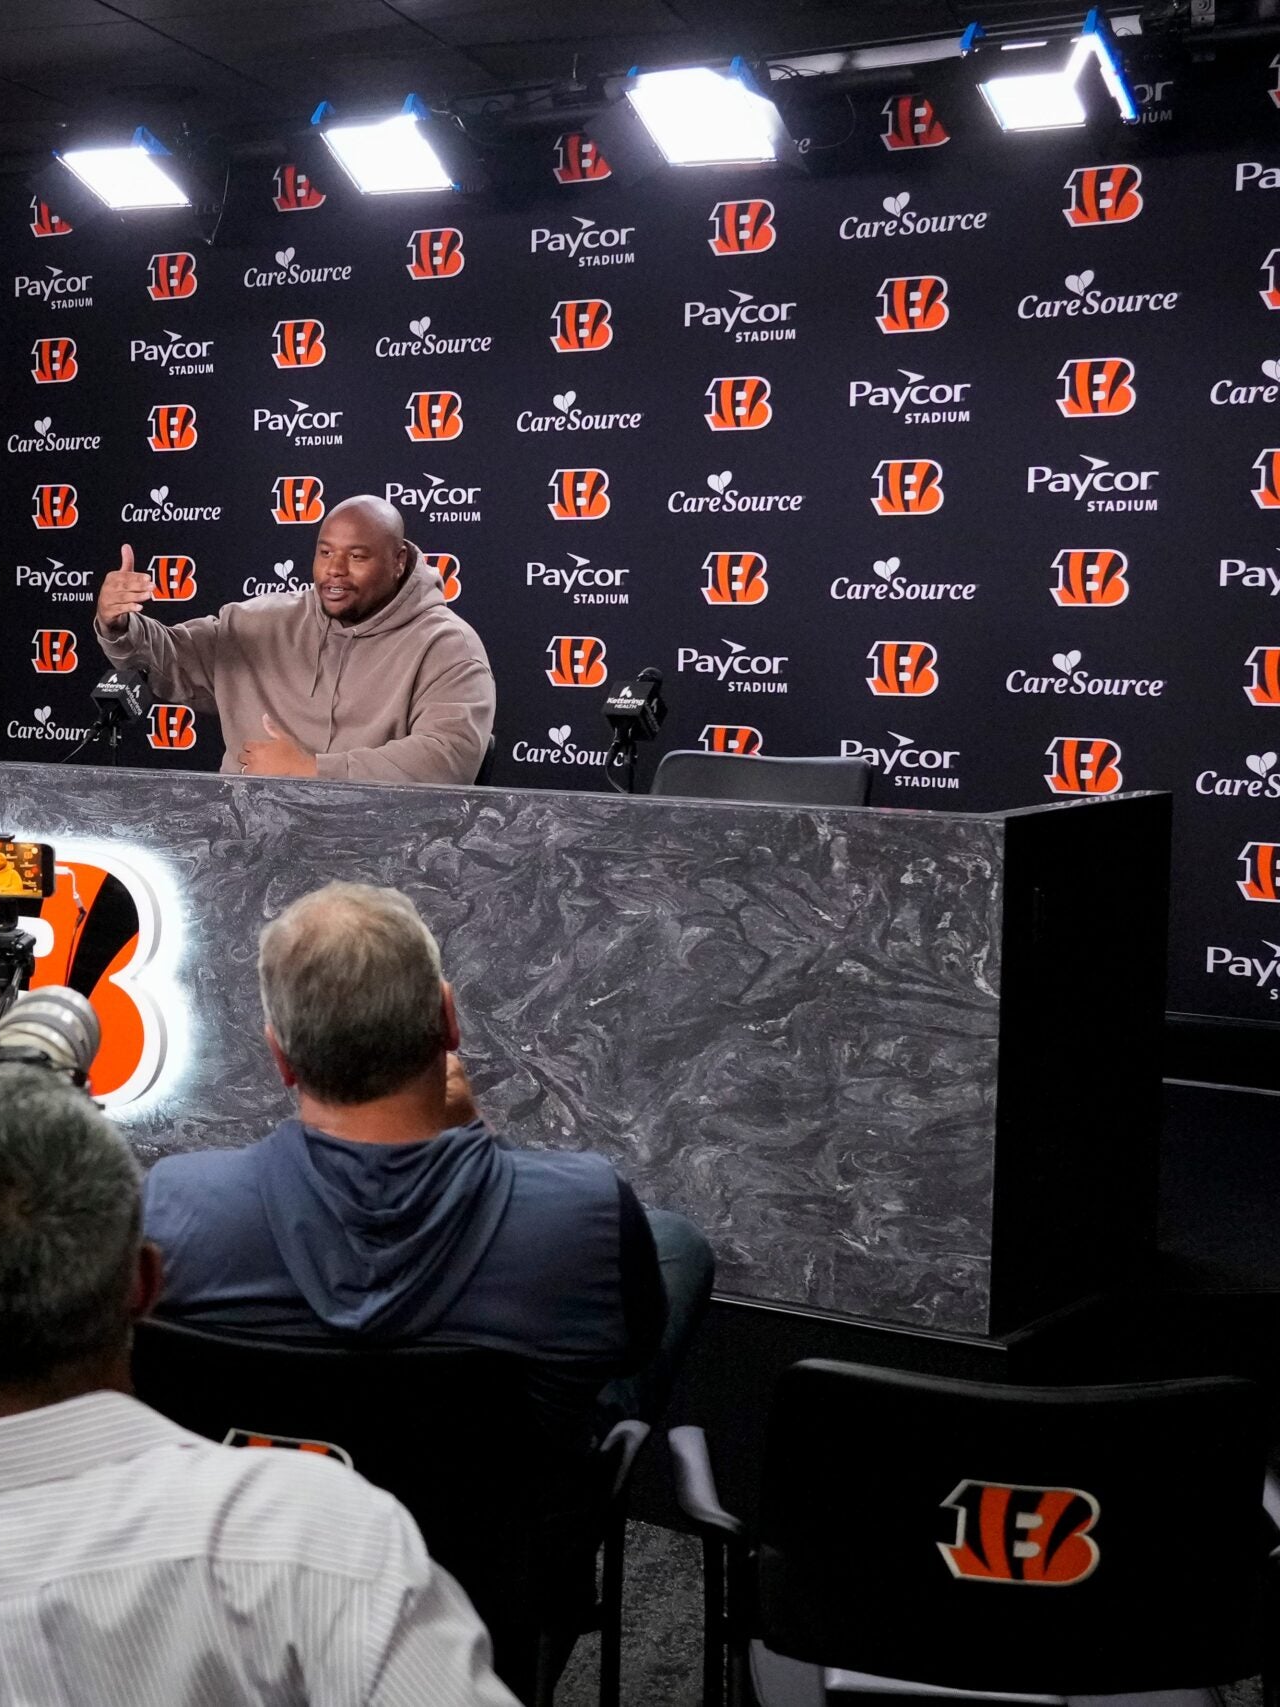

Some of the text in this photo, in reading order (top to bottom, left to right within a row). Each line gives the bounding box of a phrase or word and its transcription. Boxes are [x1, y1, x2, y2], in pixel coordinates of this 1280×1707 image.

[840, 212, 987, 239] CareSource
[532, 228, 635, 257] Paycor
[579, 253, 634, 267] STADIUM
[244, 264, 351, 287] CareSource
[16, 276, 92, 301] Paycor
[51, 298, 92, 309] STADIUM
[1018, 291, 1177, 319] CareSource
[685, 302, 796, 332] Paycor
[376, 334, 491, 357] CareSource
[736, 329, 795, 342] STADIUM
[131, 341, 213, 366] Paycor
[169, 364, 213, 375] STADIUM
[850, 382, 970, 413] Paycor
[255, 409, 343, 436] Paycor
[517, 409, 641, 432] CareSource
[905, 411, 969, 424] STADIUM
[8, 433, 100, 452] CareSource
[295, 435, 342, 446] STADIUM
[1028, 467, 1159, 500] Paycor
[386, 483, 481, 512] Paycor
[668, 490, 802, 512] CareSource
[1088, 500, 1157, 511] STADIUM
[122, 503, 221, 522] CareSource
[430, 512, 480, 521] STADIUM
[17, 566, 93, 592] Paycor
[242, 576, 314, 596] CareSo
[527, 563, 629, 593] Paycor
[831, 577, 976, 599] CareSource
[1220, 559, 1280, 596] Pay
[52, 593, 93, 601] STADIUM
[574, 594, 628, 604] STADIUM
[678, 648, 788, 680] Paycor
[729, 682, 787, 693] STADIUM
[1006, 670, 1163, 696] CareSource
[7, 720, 99, 741] CareSourc
[512, 741, 624, 767] CareSourc
[895, 776, 958, 788] STADIUM
[1195, 771, 1280, 798] CareS
[1207, 946, 1280, 987] Pay
